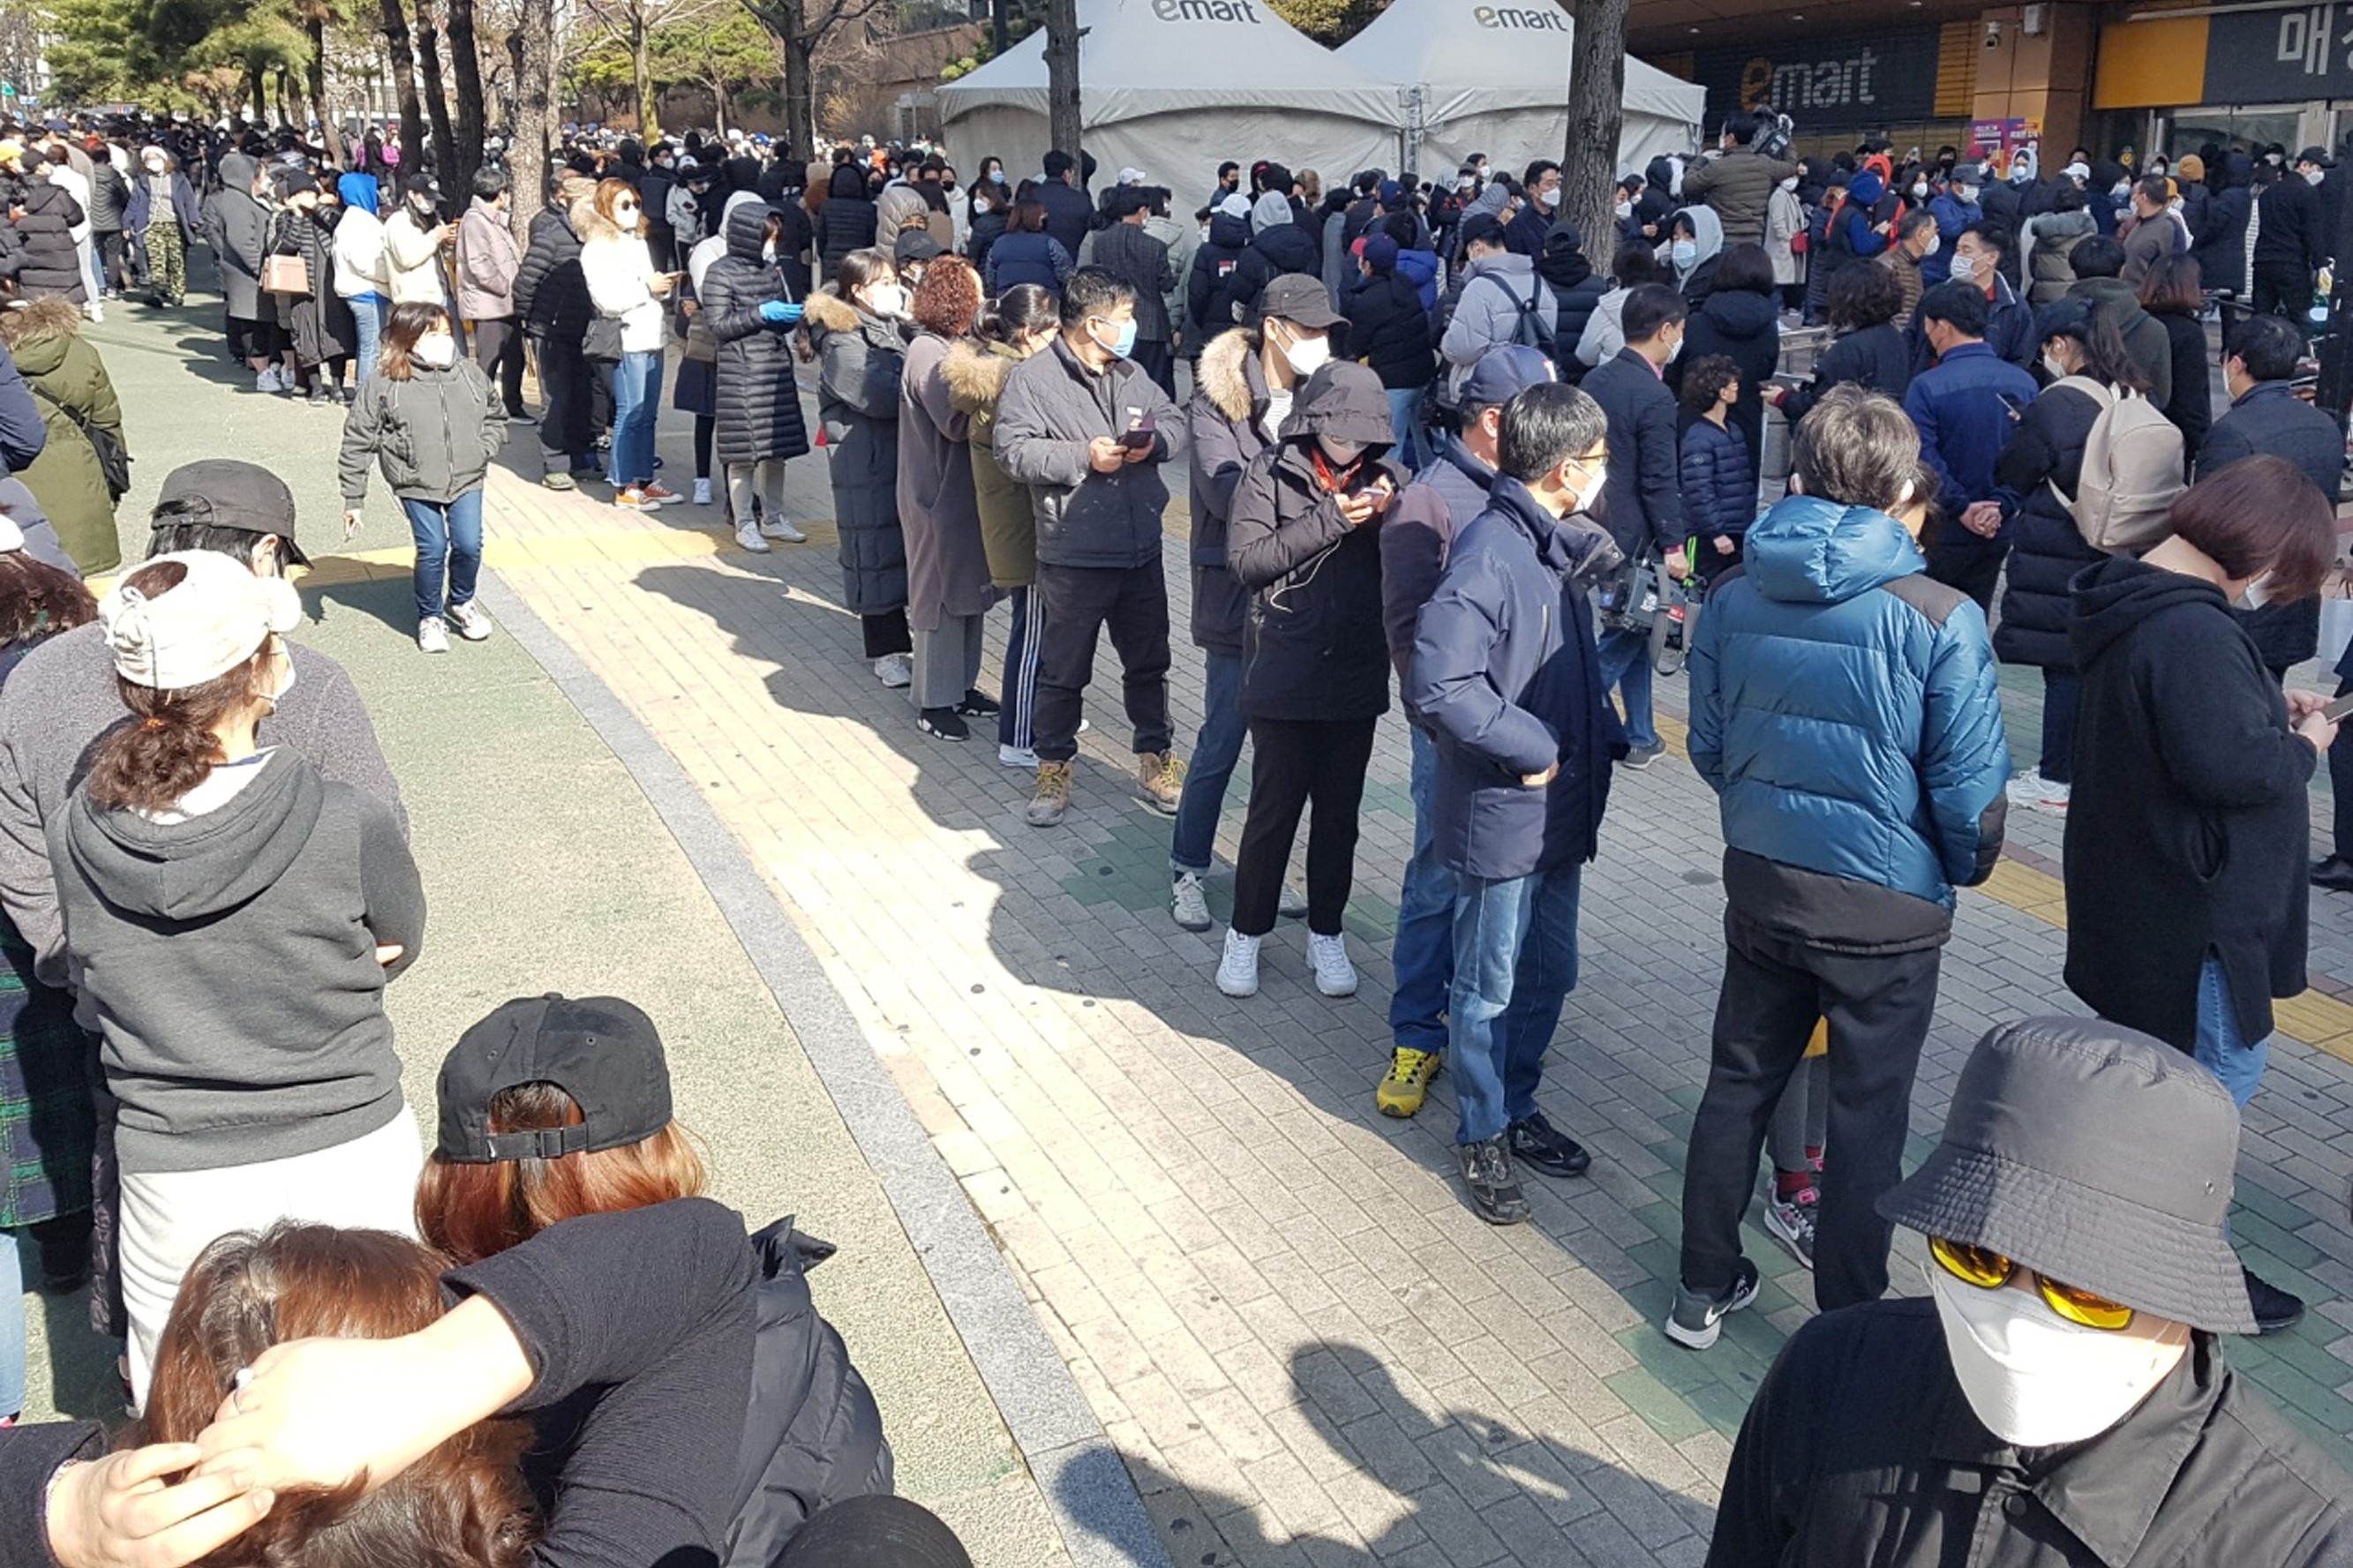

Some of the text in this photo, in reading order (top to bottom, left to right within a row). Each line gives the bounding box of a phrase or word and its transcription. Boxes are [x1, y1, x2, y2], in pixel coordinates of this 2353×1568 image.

[1151, 0, 1261, 24] emart
[1473, 6, 1568, 32] emart
[2277, 4, 2353, 76] 매
[1740, 47, 1878, 113] emart
